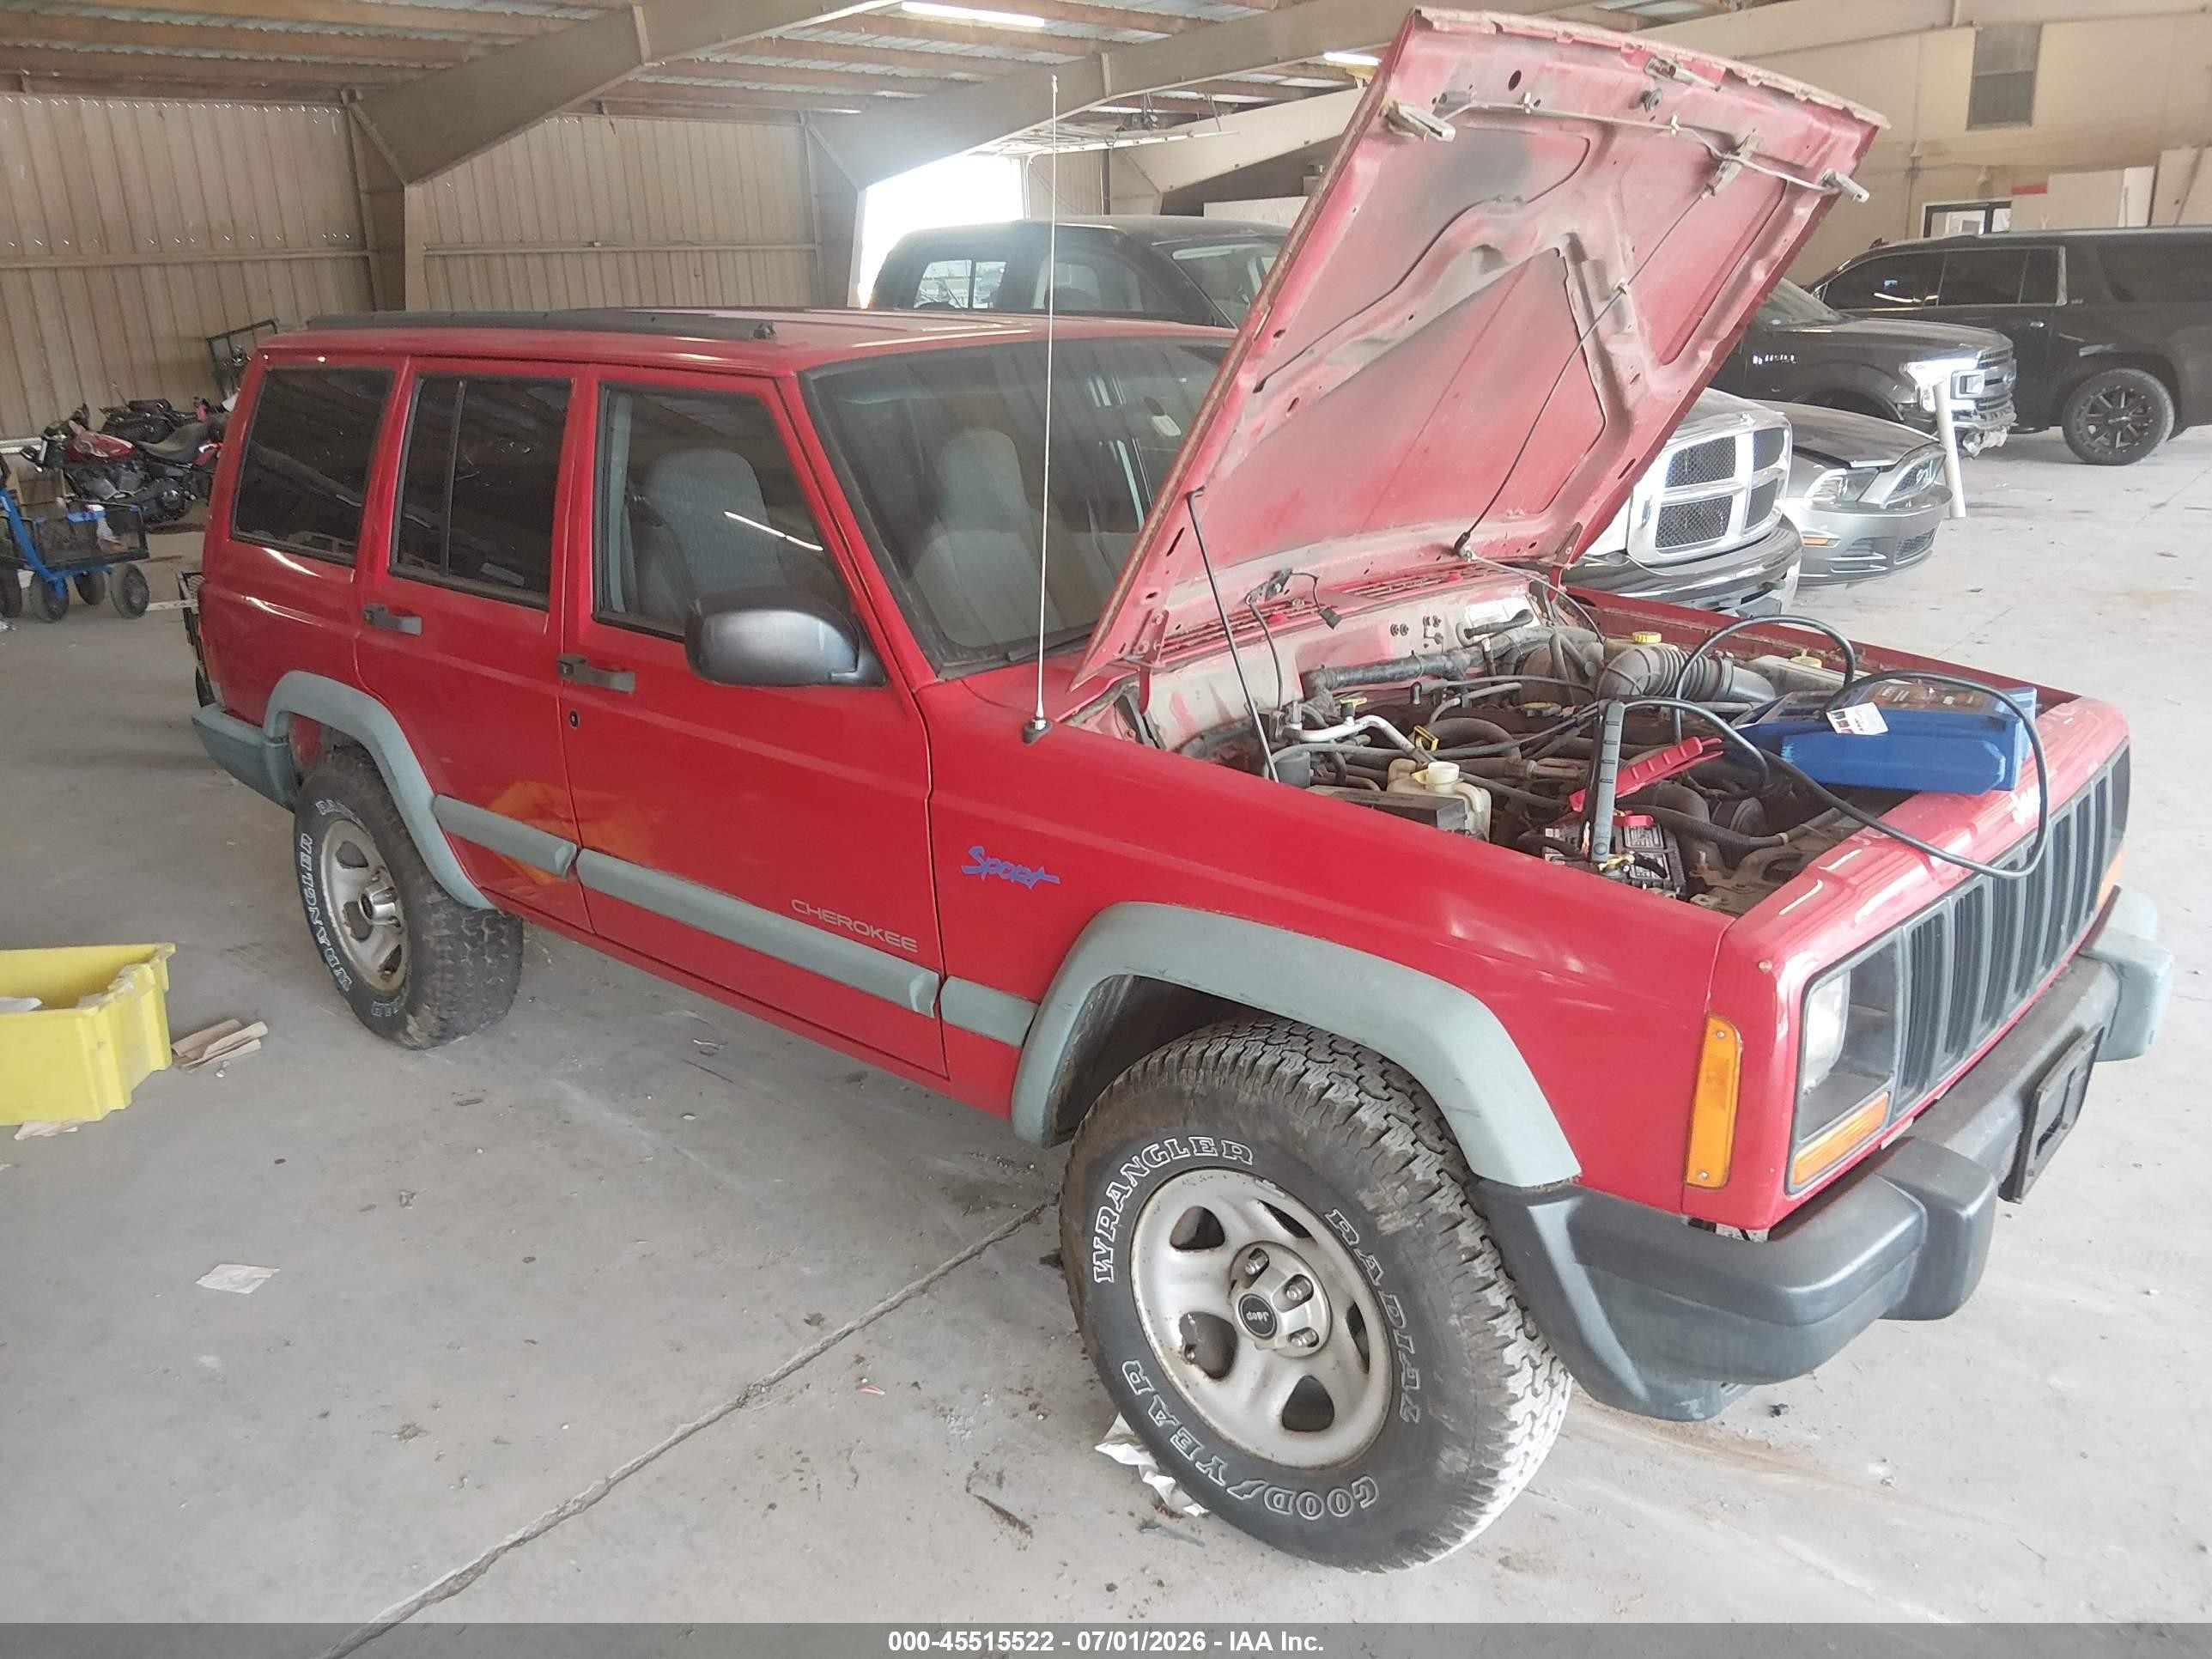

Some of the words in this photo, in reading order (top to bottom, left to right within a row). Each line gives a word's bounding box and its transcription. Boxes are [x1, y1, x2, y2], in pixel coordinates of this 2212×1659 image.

[300, 832, 354, 993] WRANGLER
[790, 898, 920, 953] CHEROKEE
[1092, 1136, 1254, 1285] WRANGLER
[1121, 1359, 1379, 1521] GOODYEAR
